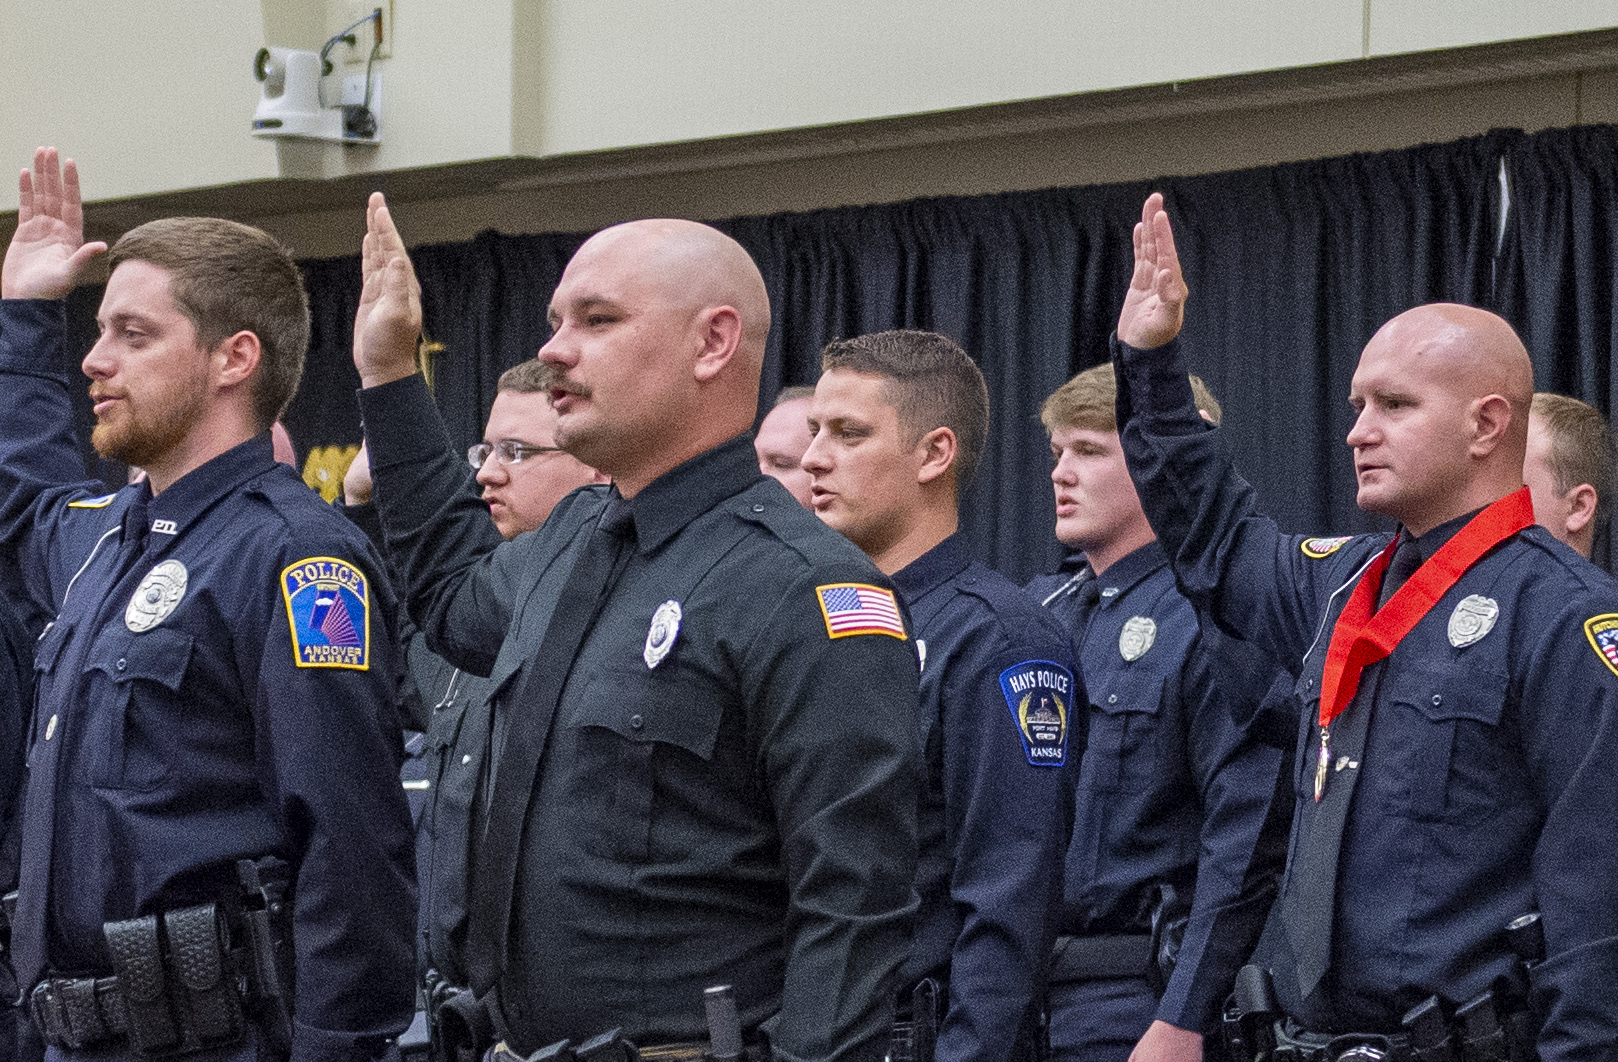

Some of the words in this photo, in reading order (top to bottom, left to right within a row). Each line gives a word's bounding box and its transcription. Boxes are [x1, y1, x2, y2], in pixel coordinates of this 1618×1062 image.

[290, 563, 360, 589] POLICE
[304, 645, 361, 657] ANDOVER
[309, 654, 359, 665] KANSAS
[1009, 671, 1036, 693] HAYS
[1037, 671, 1069, 694] POLICE
[1030, 747, 1062, 759] KANSAS
